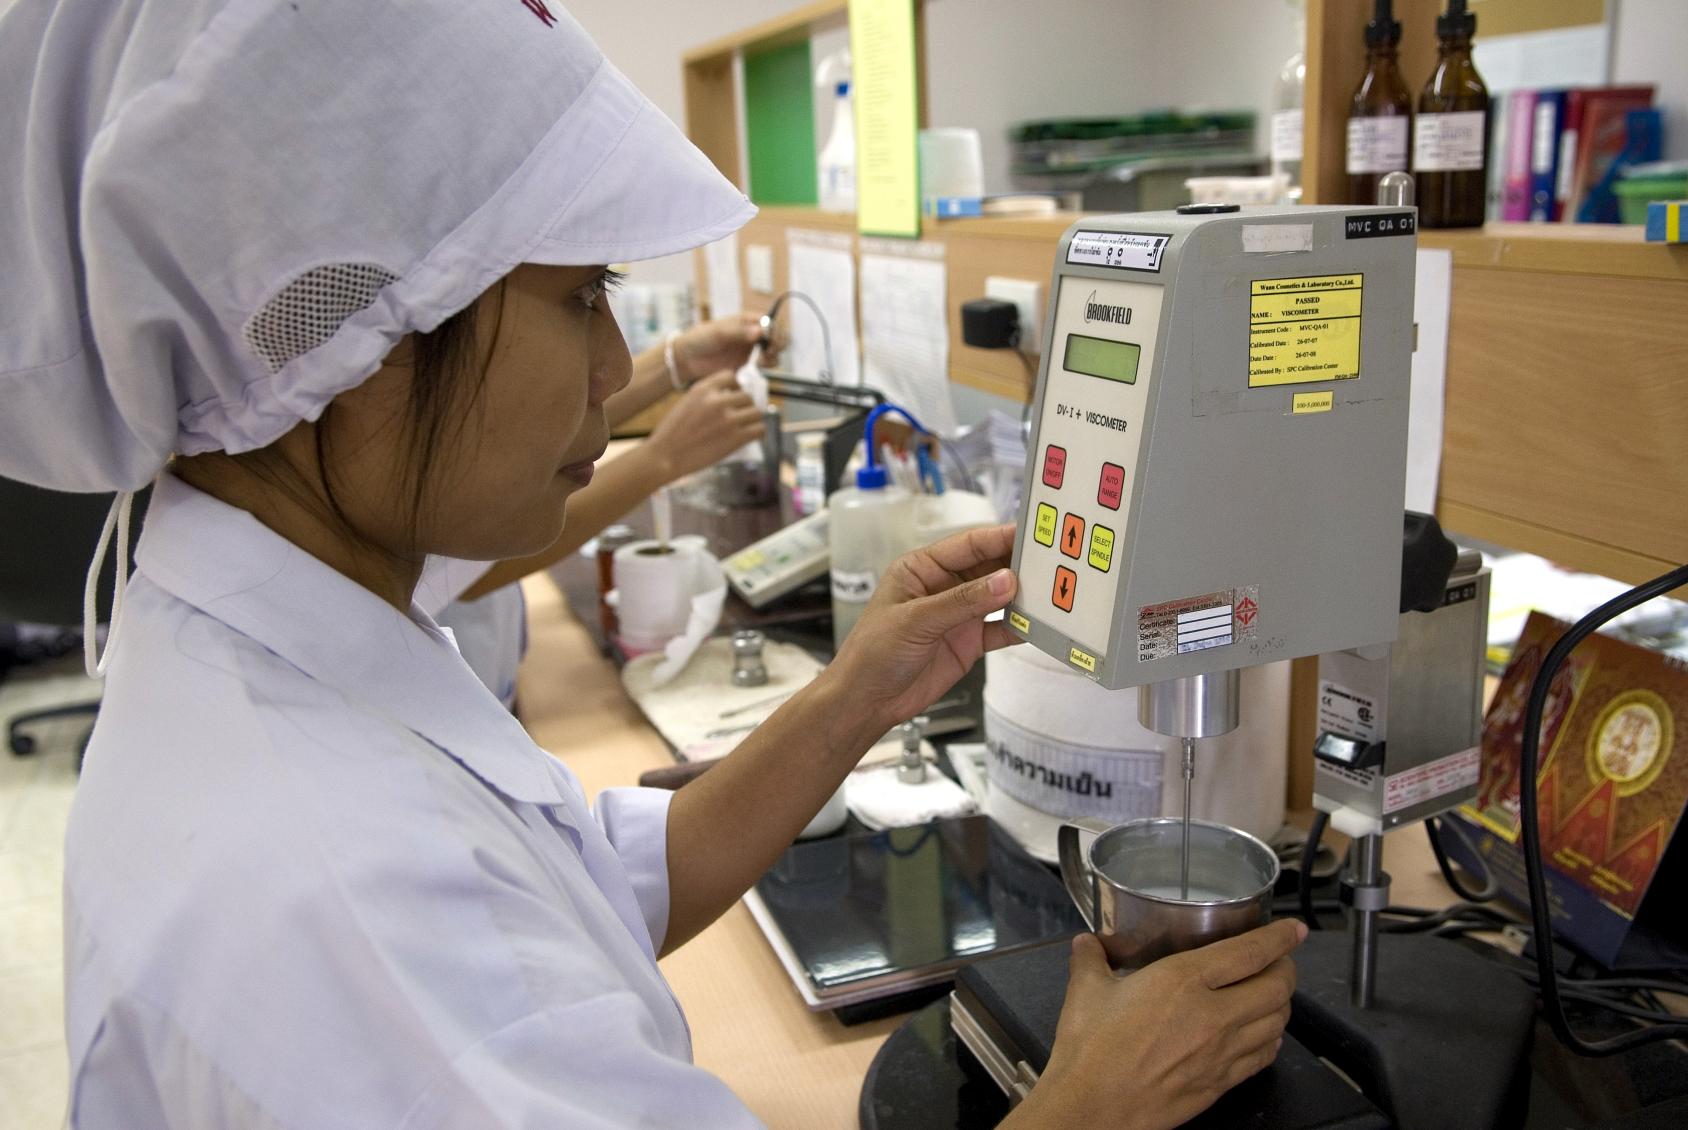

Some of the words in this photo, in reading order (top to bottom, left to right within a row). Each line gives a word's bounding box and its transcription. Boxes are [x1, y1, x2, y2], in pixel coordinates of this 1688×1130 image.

[1348, 221, 1371, 232] MVC
[1400, 218, 1413, 229] 01
[1307, 280, 1334, 288] Laboratory
[1295, 296, 1320, 304] PASSED
[1086, 303, 1132, 325] BROOKFIELD
[1281, 308, 1319, 316] VISCOMETER
[1300, 323, 1329, 331] MVC-QA-01
[1086, 411, 1127, 432] VISCOMETER
[1048, 456, 1062, 466] MOTOR
[1105, 475, 1118, 485] AUTO
[1102, 488, 1118, 499] RANGE
[1042, 513, 1051, 522] SET
[1038, 526, 1051, 537] SPEED
[1094, 535, 1111, 548] SELECT
[1091, 548, 1110, 561] SPINDLE
[1140, 619, 1175, 630] Certificate:
[1140, 643, 1158, 651] Date:
[1140, 653, 1156, 661] Due:
